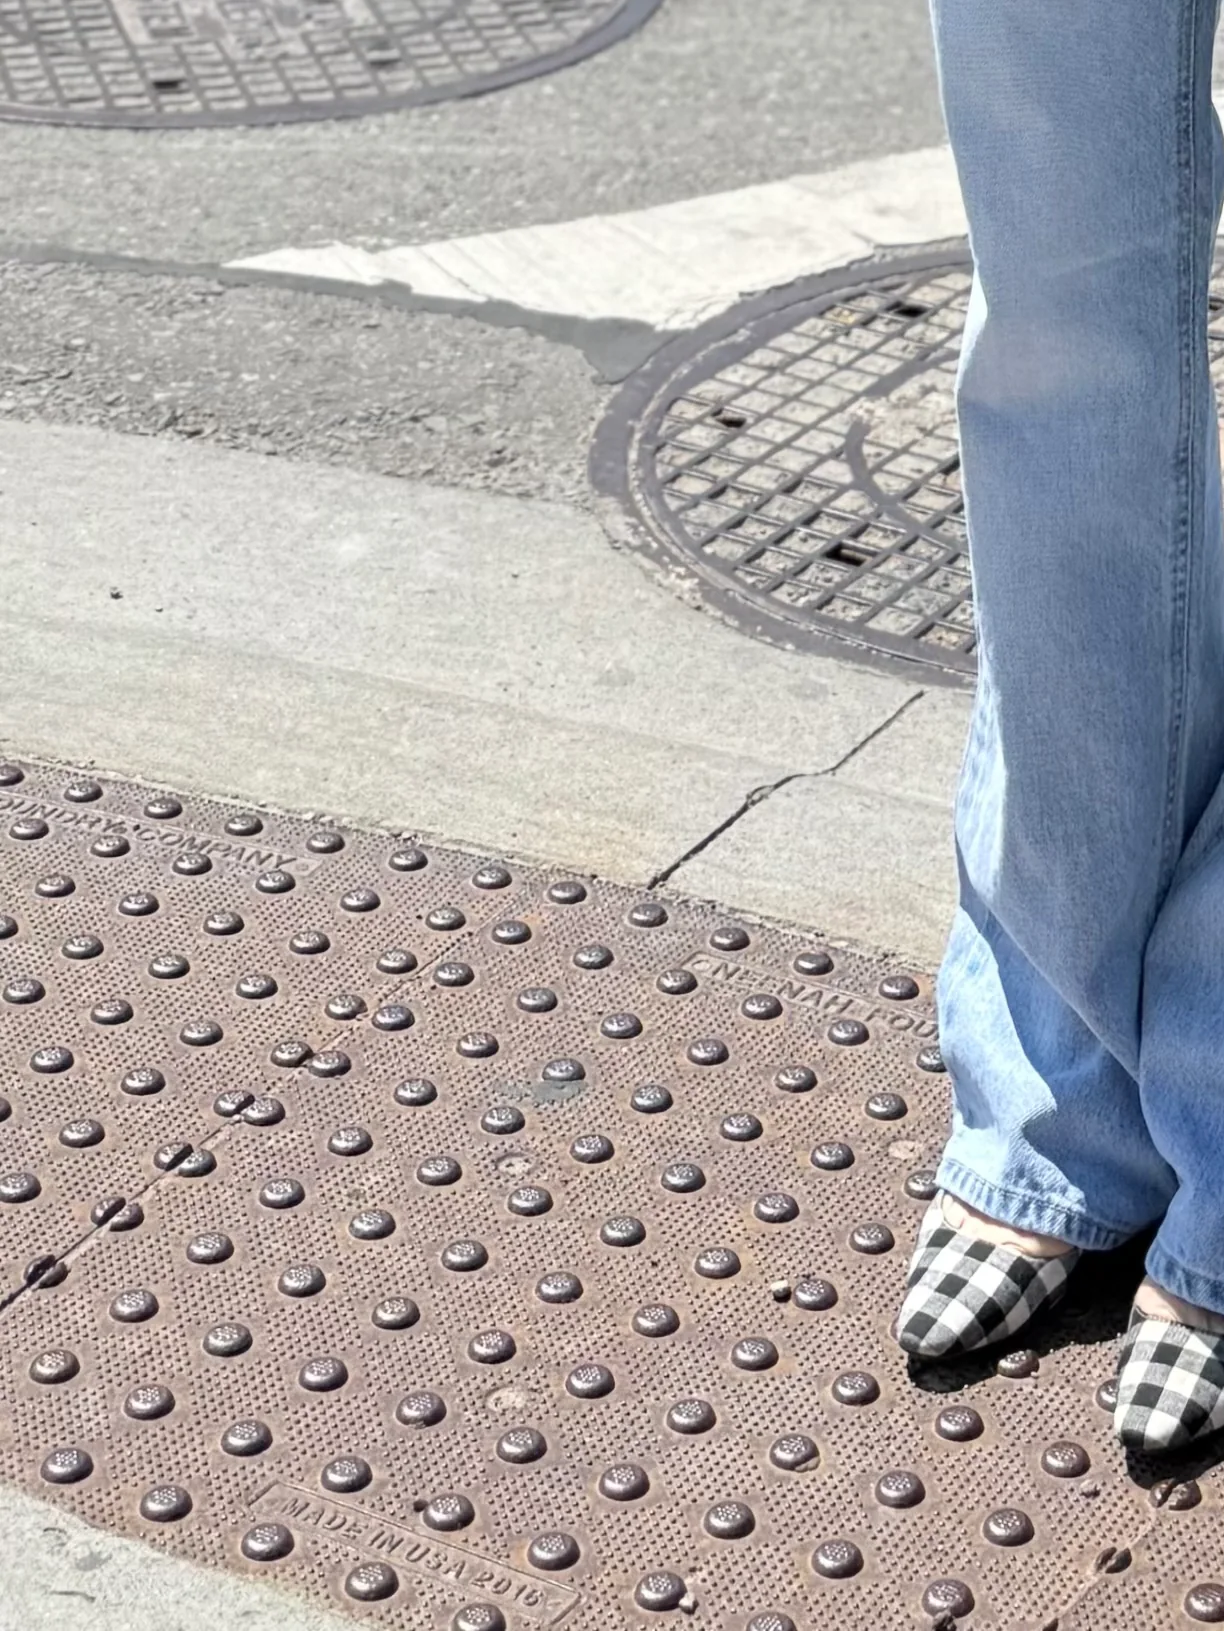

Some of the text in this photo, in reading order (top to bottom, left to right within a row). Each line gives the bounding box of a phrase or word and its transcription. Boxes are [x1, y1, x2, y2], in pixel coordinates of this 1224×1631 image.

[135, 825, 297, 869] COMPANY
[281, 1498, 545, 1607] MADE IN USA 2016
